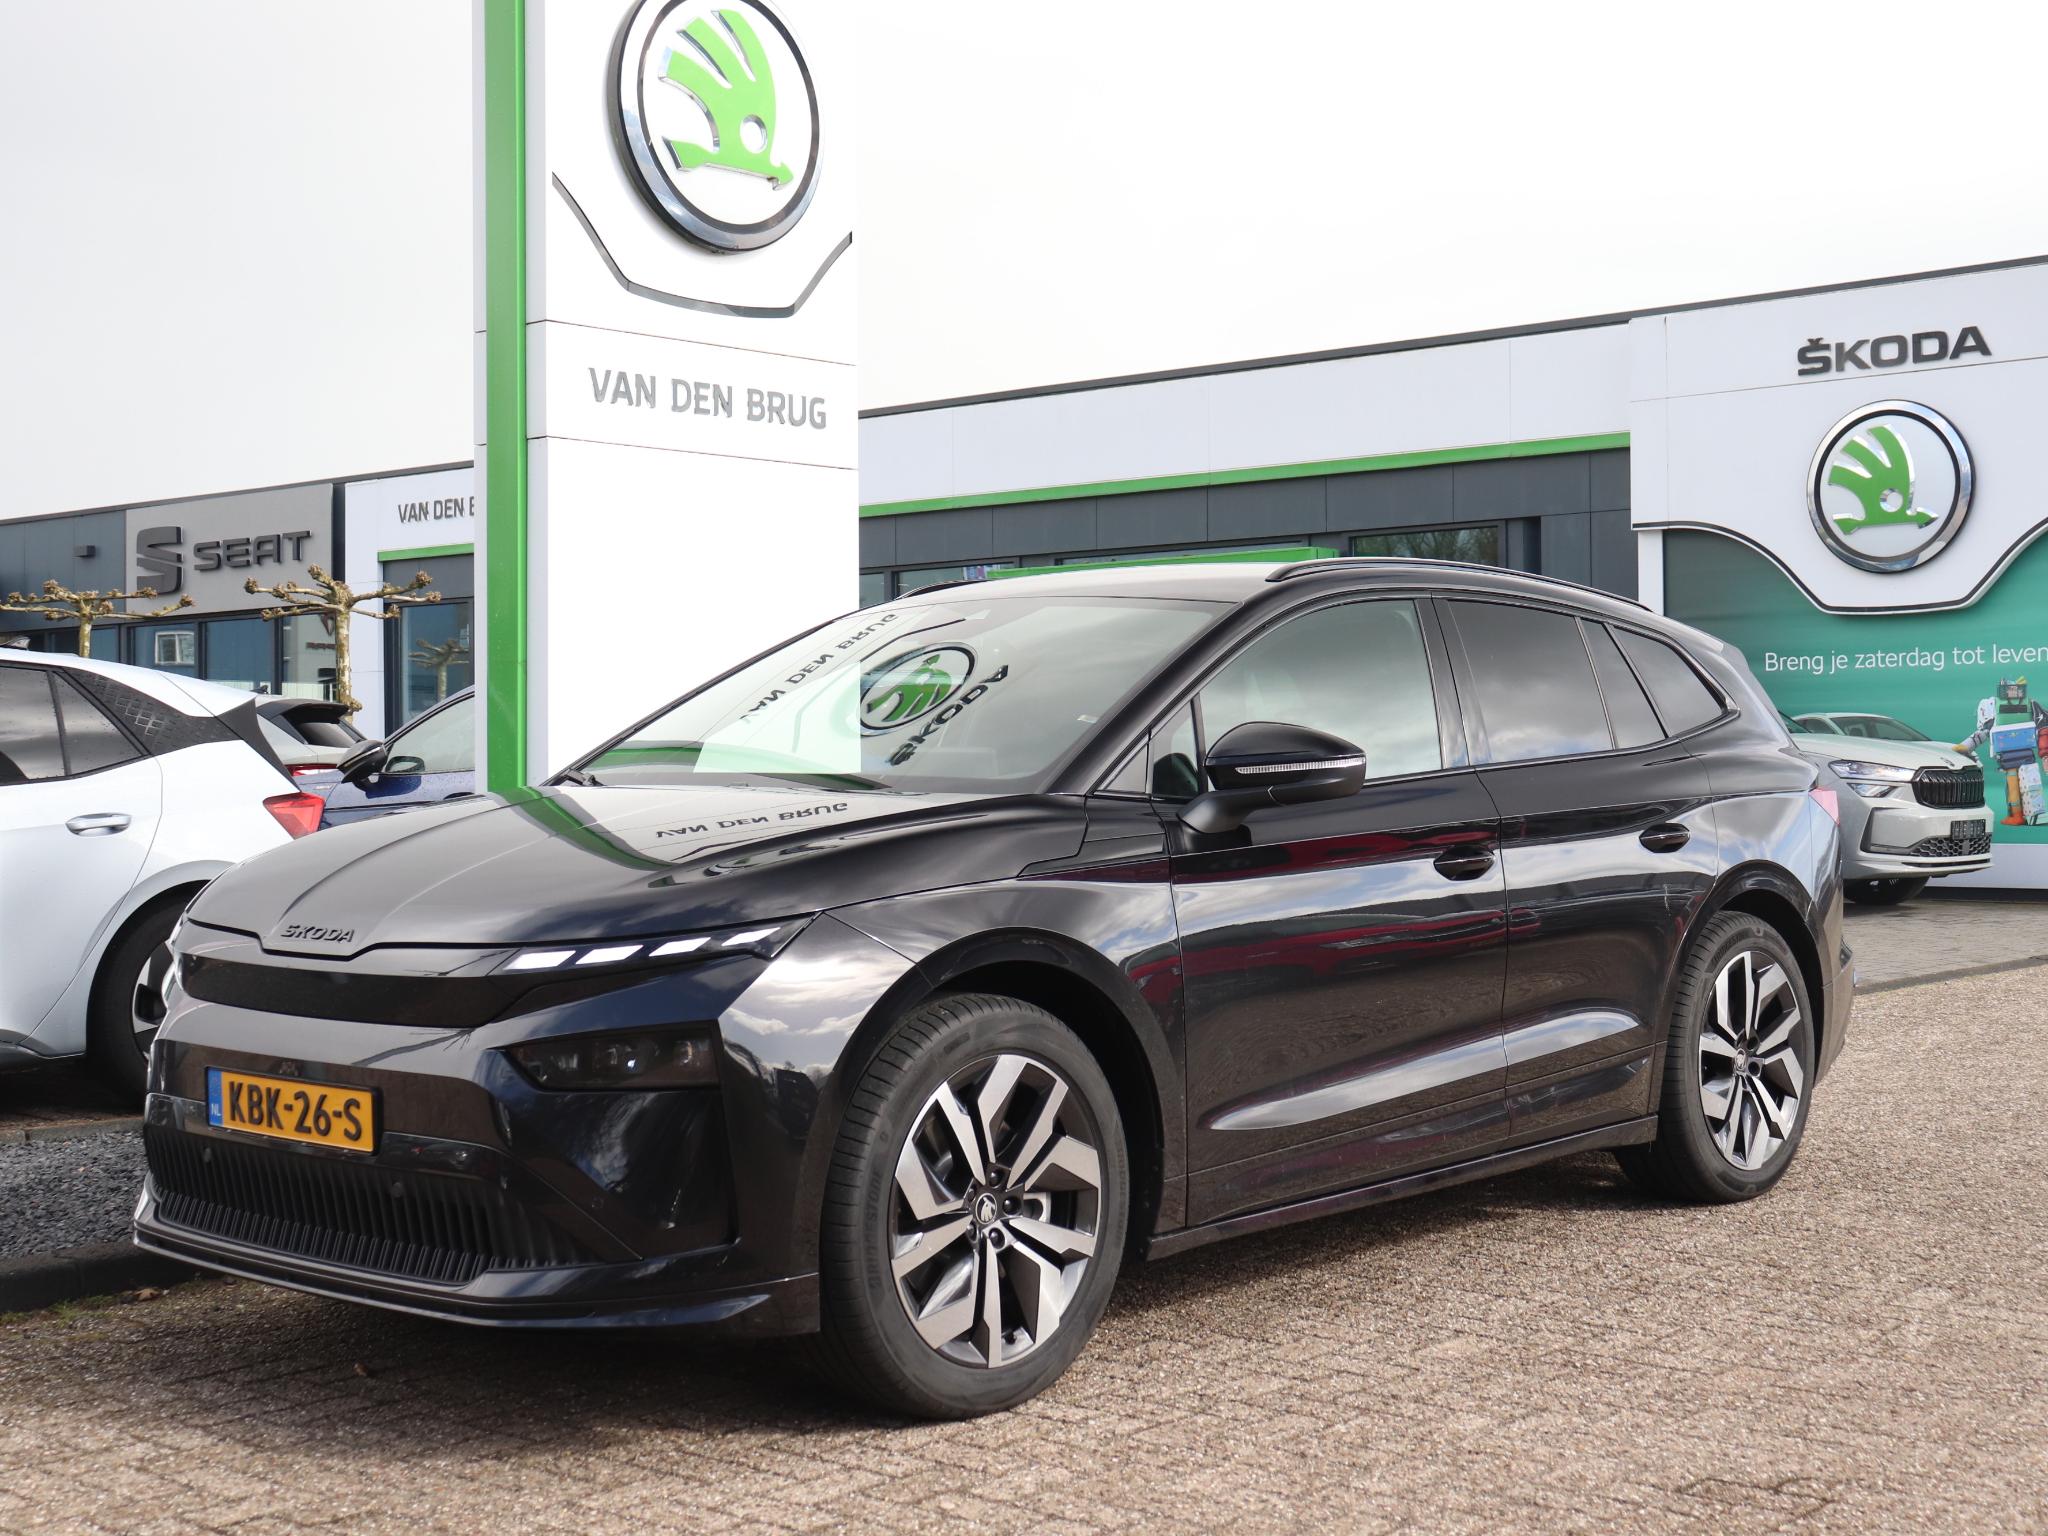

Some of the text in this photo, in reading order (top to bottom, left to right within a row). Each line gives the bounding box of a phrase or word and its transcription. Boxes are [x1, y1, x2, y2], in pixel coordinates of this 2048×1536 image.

[1798, 326, 1992, 376] ŠKODA
[588, 367, 827, 429] VAN DEN BRUG
[398, 501, 429, 523] VAN
[433, 497, 464, 520] DEN
[193, 530, 312, 571] SEAT
[1765, 652, 1824, 675] Breng
[1829, 650, 1848, 674] je
[1855, 647, 1944, 671] zaterdag
[1952, 646, 1985, 665] tot
[280, 925, 355, 943] ŠKODA
[211, 1103, 221, 1117] NL
[229, 1081, 362, 1142] KBK-26-S
